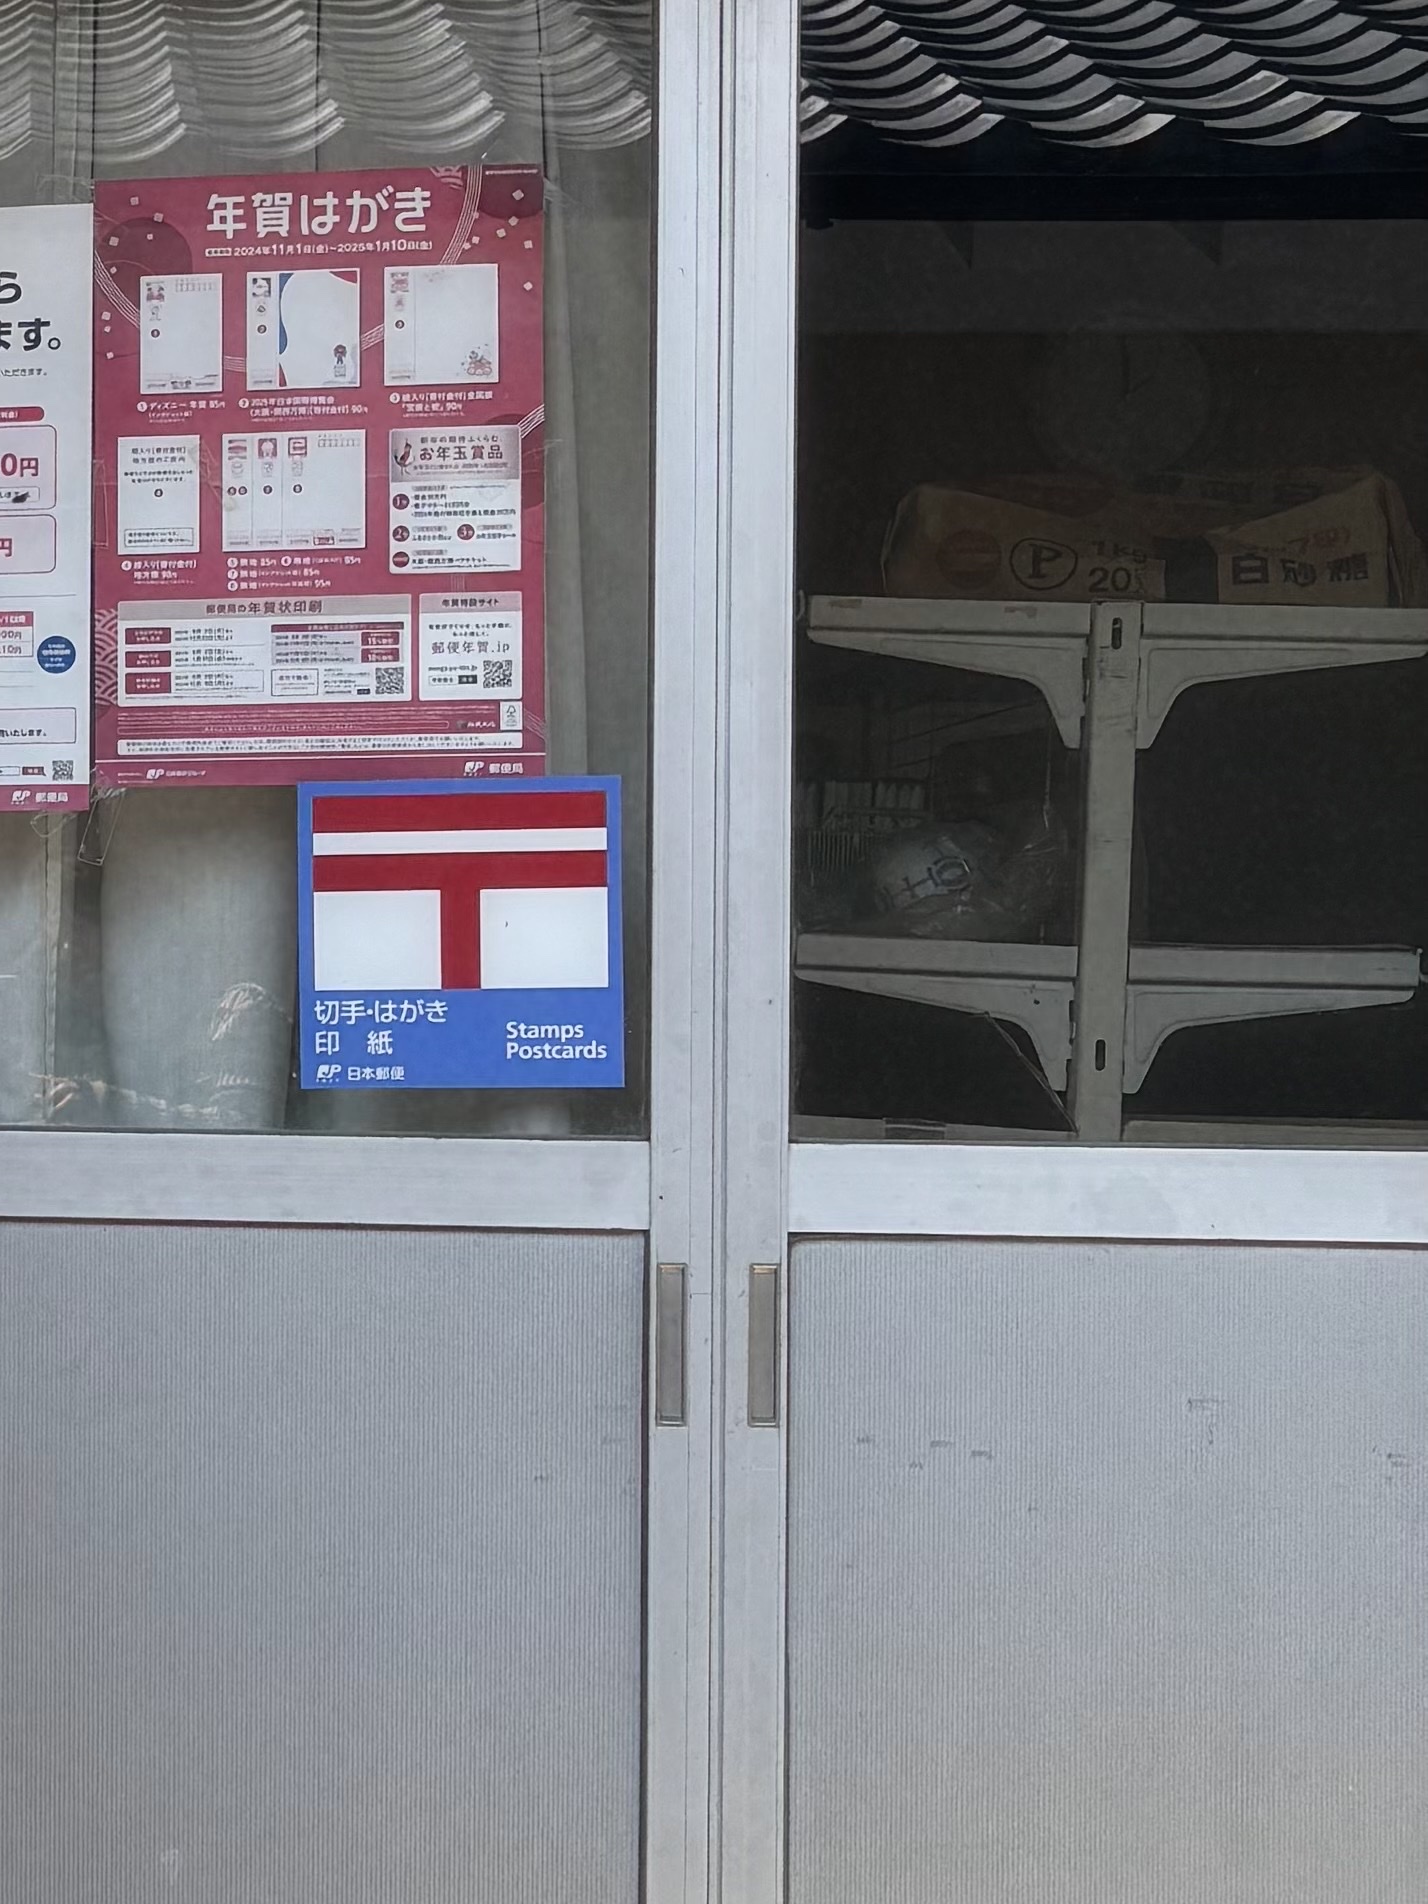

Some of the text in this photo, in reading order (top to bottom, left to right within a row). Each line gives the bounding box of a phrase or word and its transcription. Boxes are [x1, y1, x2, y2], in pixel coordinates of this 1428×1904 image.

[206, 184, 431, 240] 年賀はがき
[419, 444, 504, 462] お年玉賞品
[205, 600, 323, 615] 郵便局の年賀状印刷
[431, 640, 510, 655] 郵便年賀.jp
[313, 998, 449, 1025] 切手・はがき
[505, 1021, 584, 1043] Stamps
[505, 1039, 608, 1060] Postcards
[347, 1065, 406, 1081] 日本郵便
